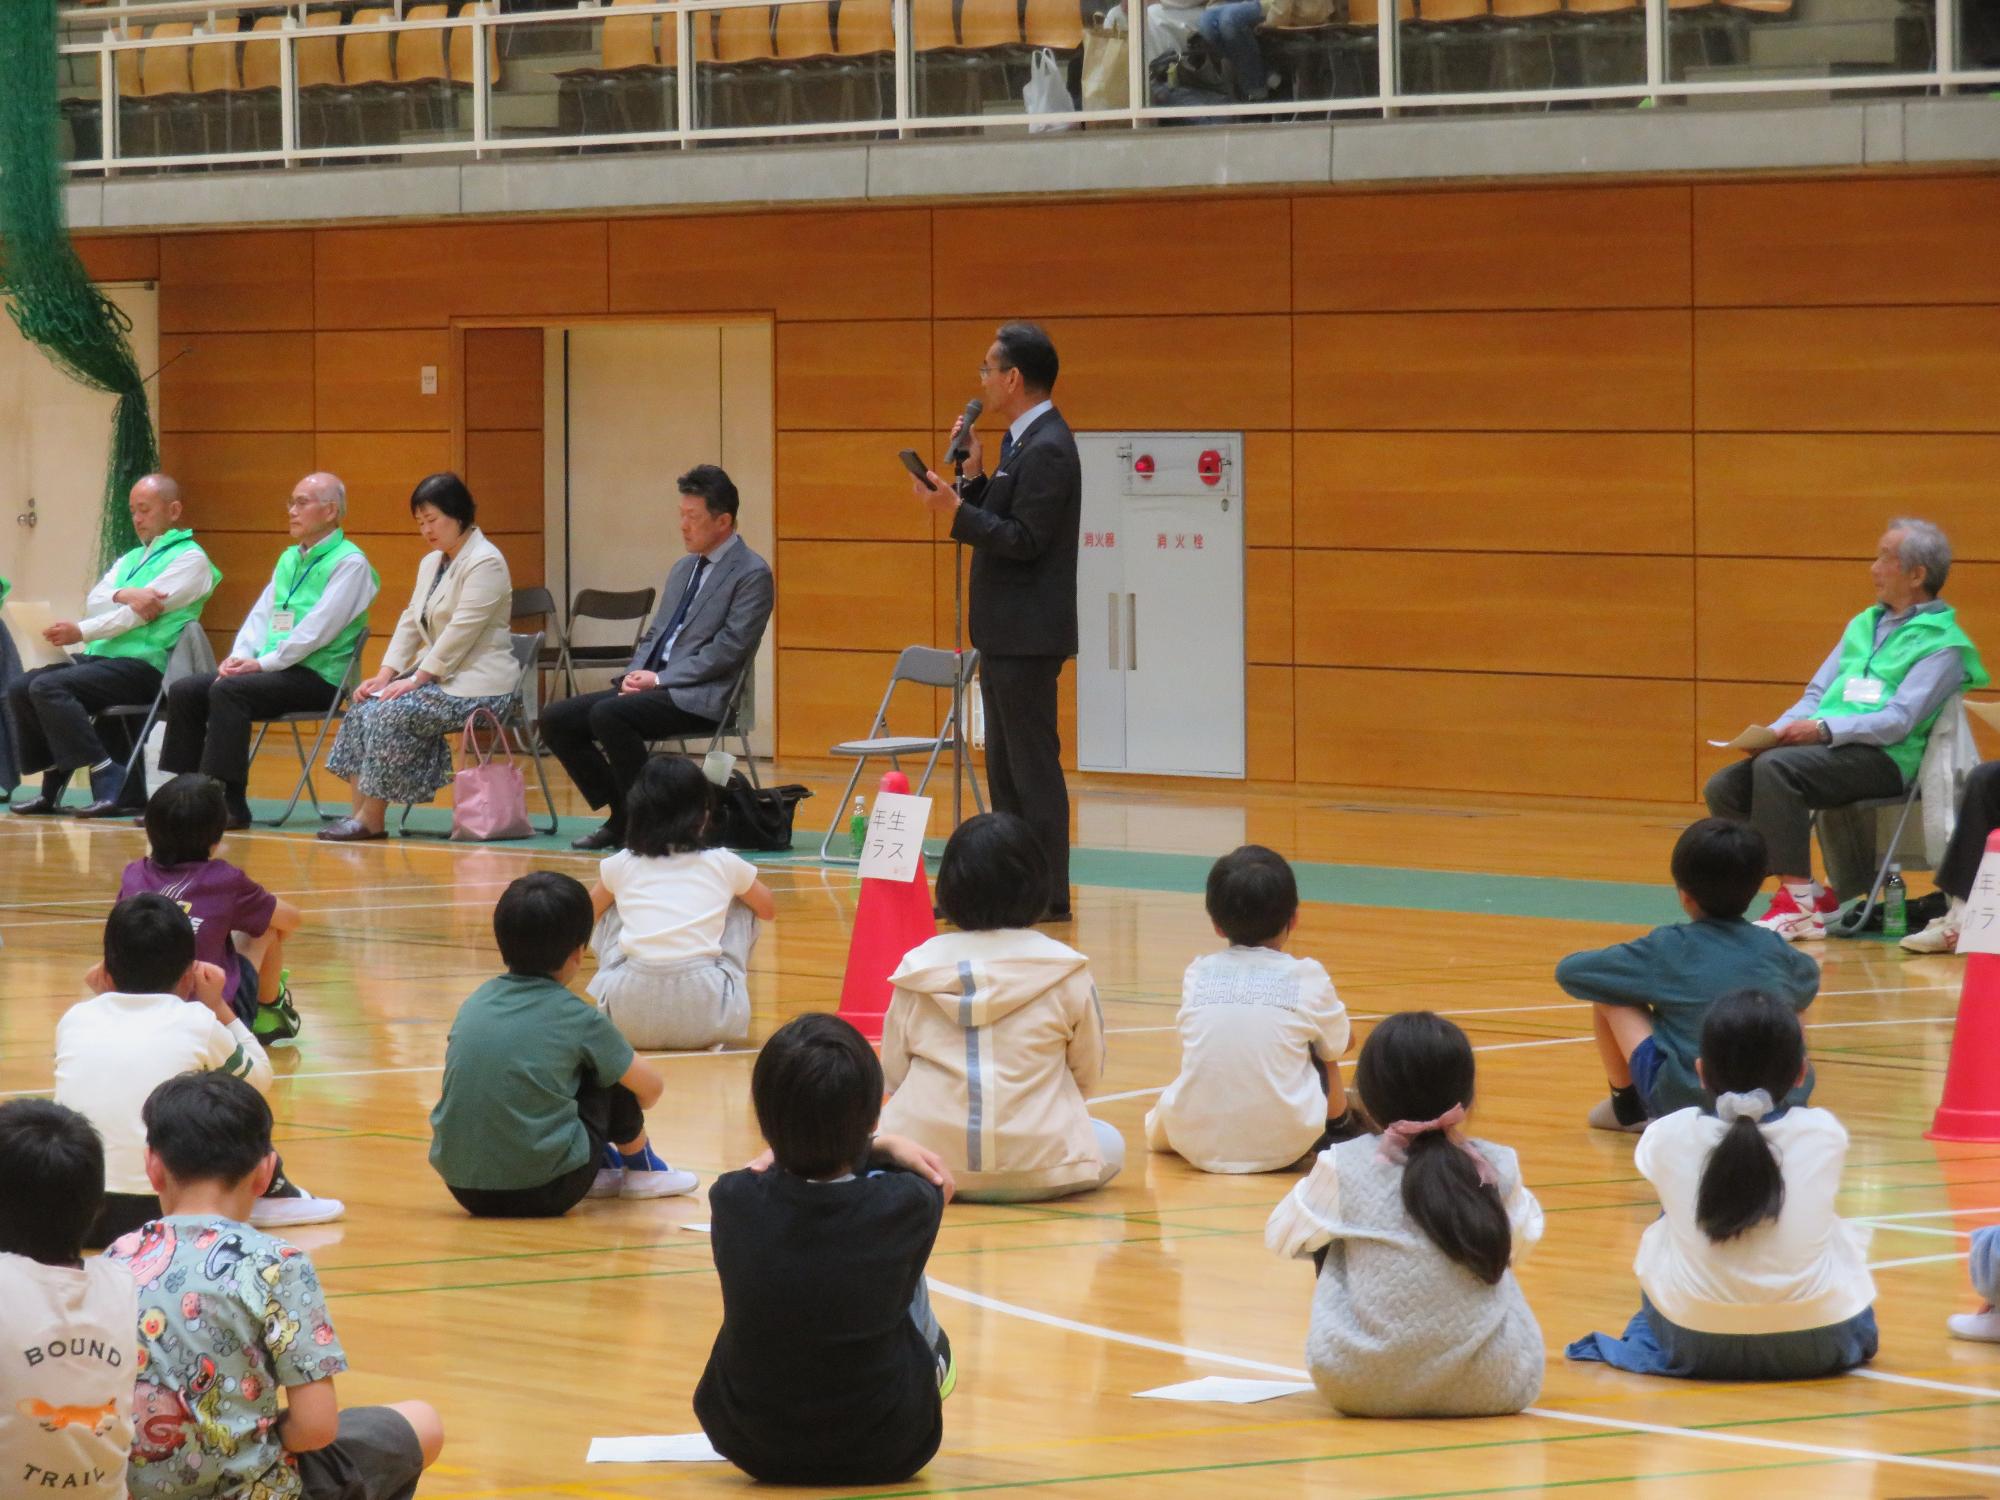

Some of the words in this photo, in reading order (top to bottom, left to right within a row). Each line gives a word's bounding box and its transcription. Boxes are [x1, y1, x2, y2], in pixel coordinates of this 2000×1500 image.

[1084, 532, 1115, 548] 消火器
[1157, 533, 1204, 550] 消火栓
[866, 838, 905, 860] ラス
[24, 1338, 122, 1368] BOUND
